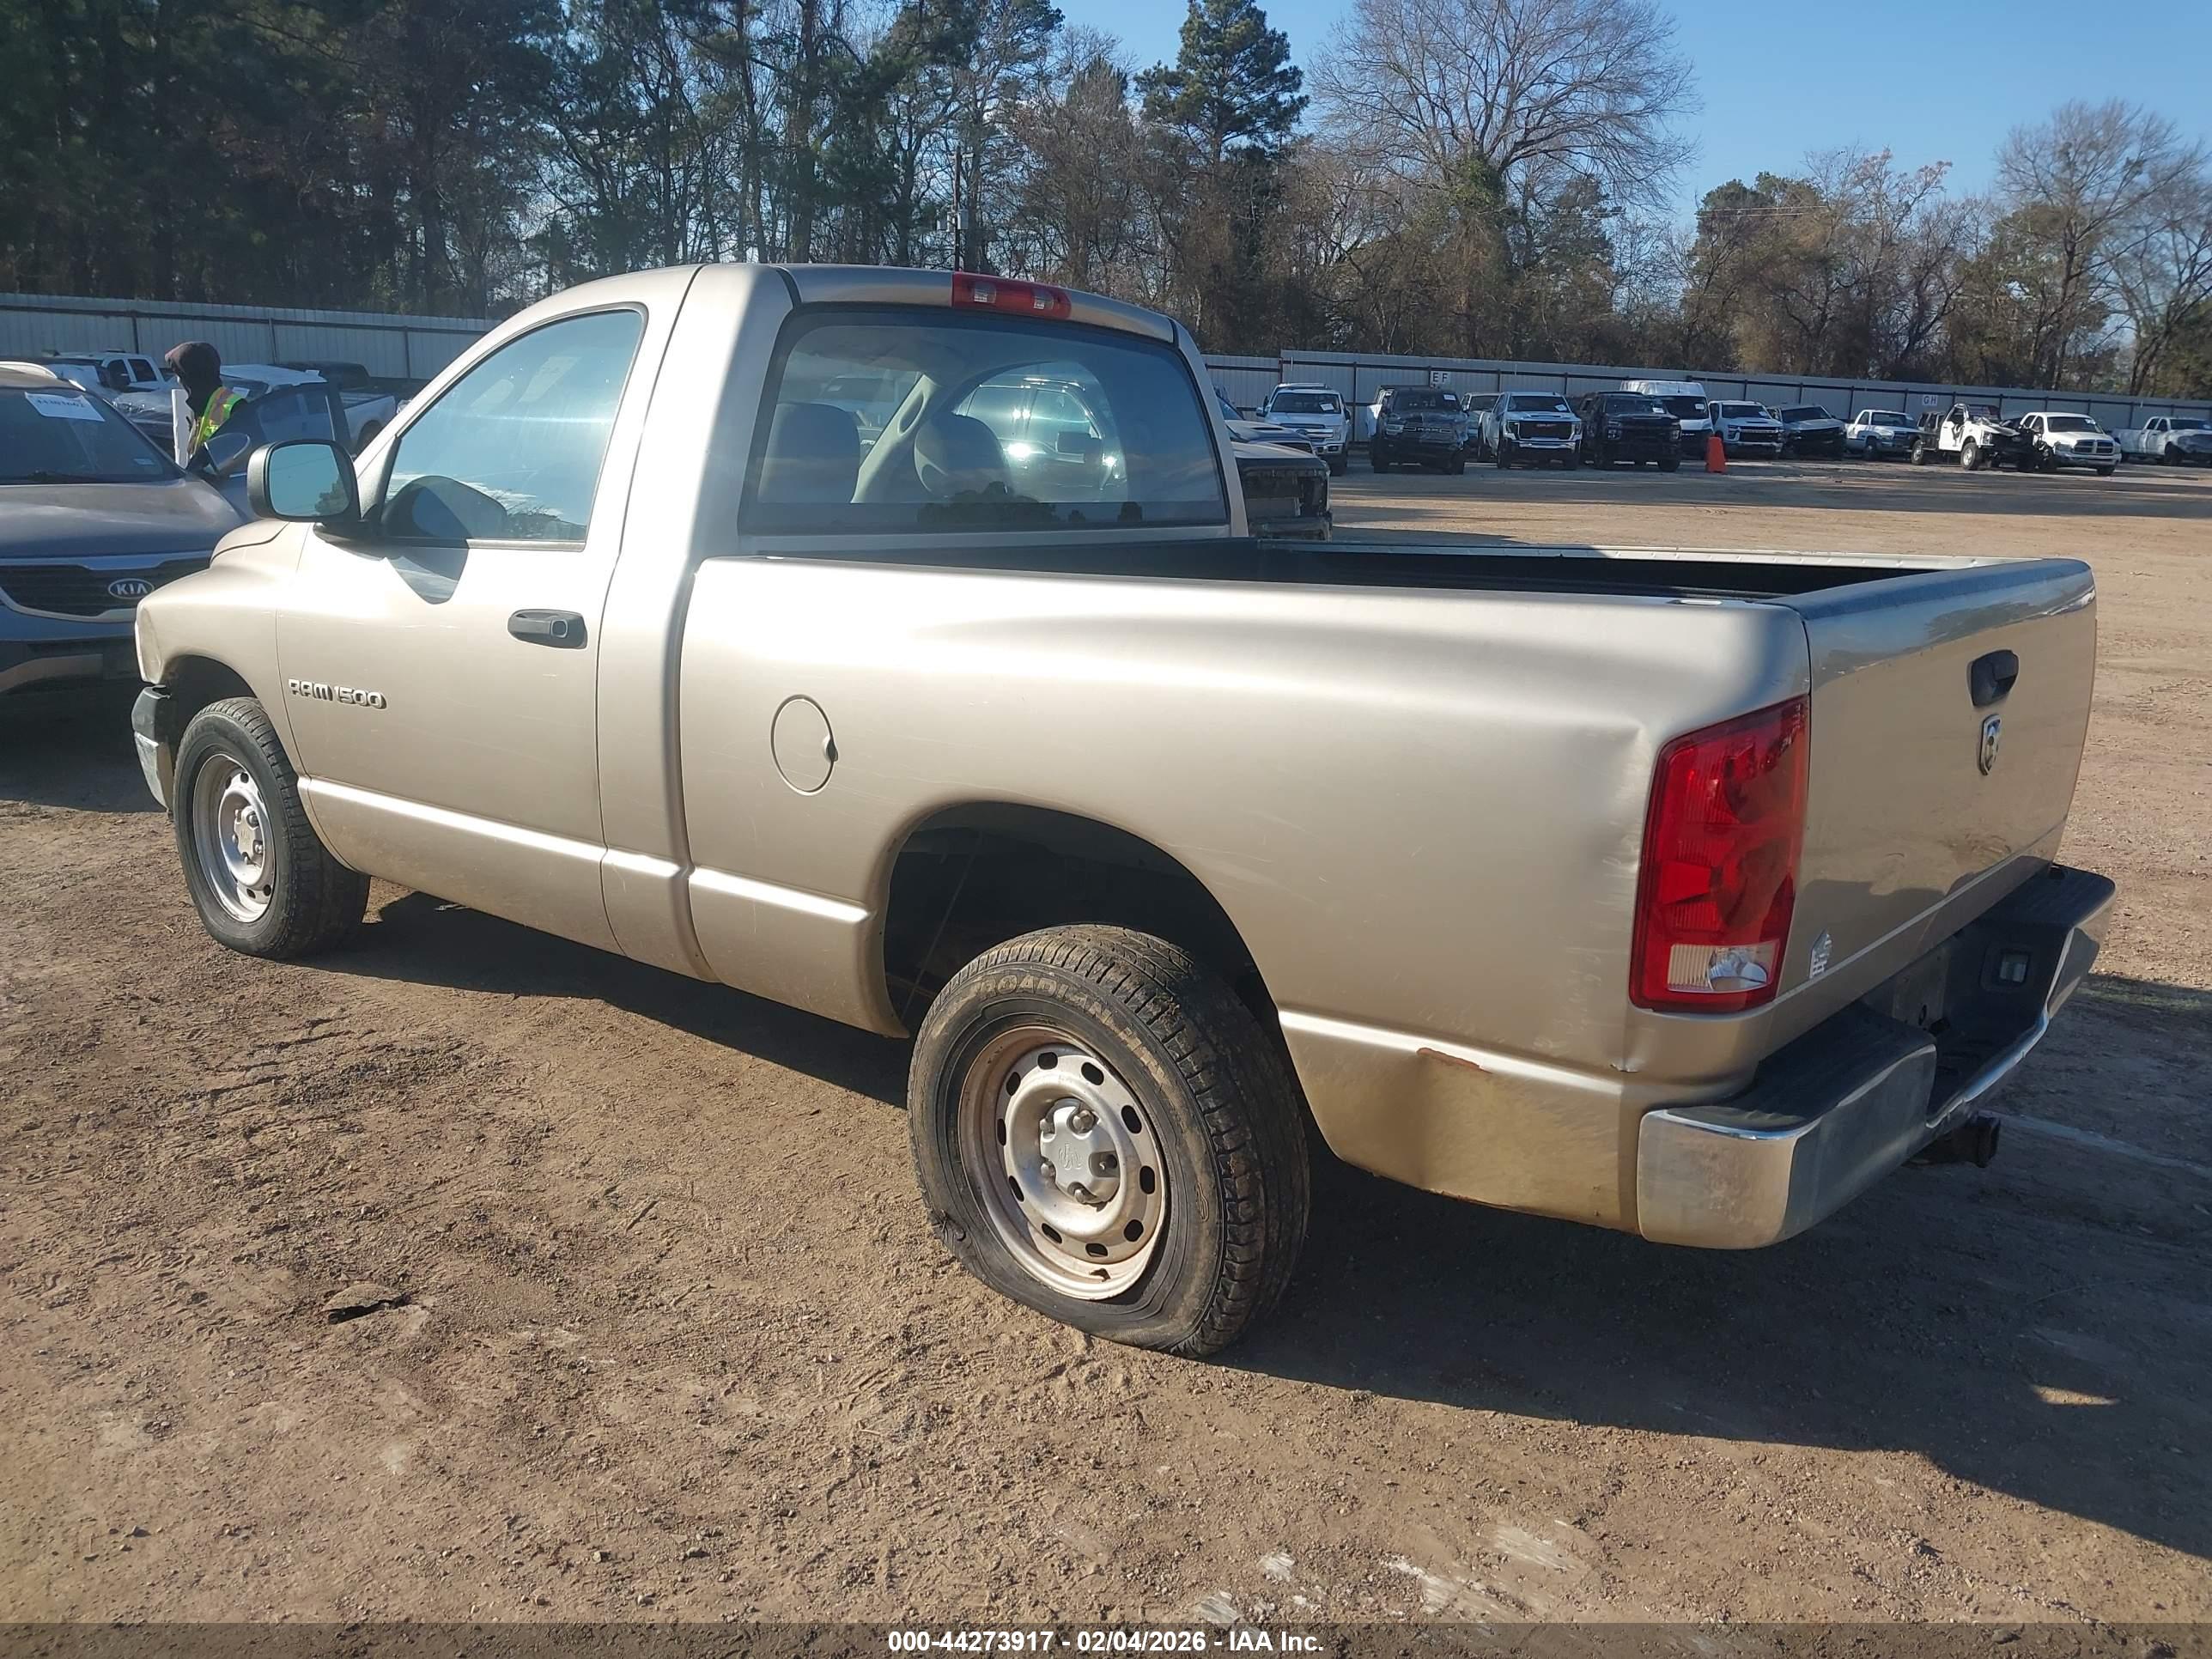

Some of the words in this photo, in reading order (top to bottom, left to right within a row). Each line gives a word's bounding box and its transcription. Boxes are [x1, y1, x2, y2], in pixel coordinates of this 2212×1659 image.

[116, 583, 148, 596] KIA
[288, 678, 333, 701] RAM
[334, 685, 387, 710] 1500
